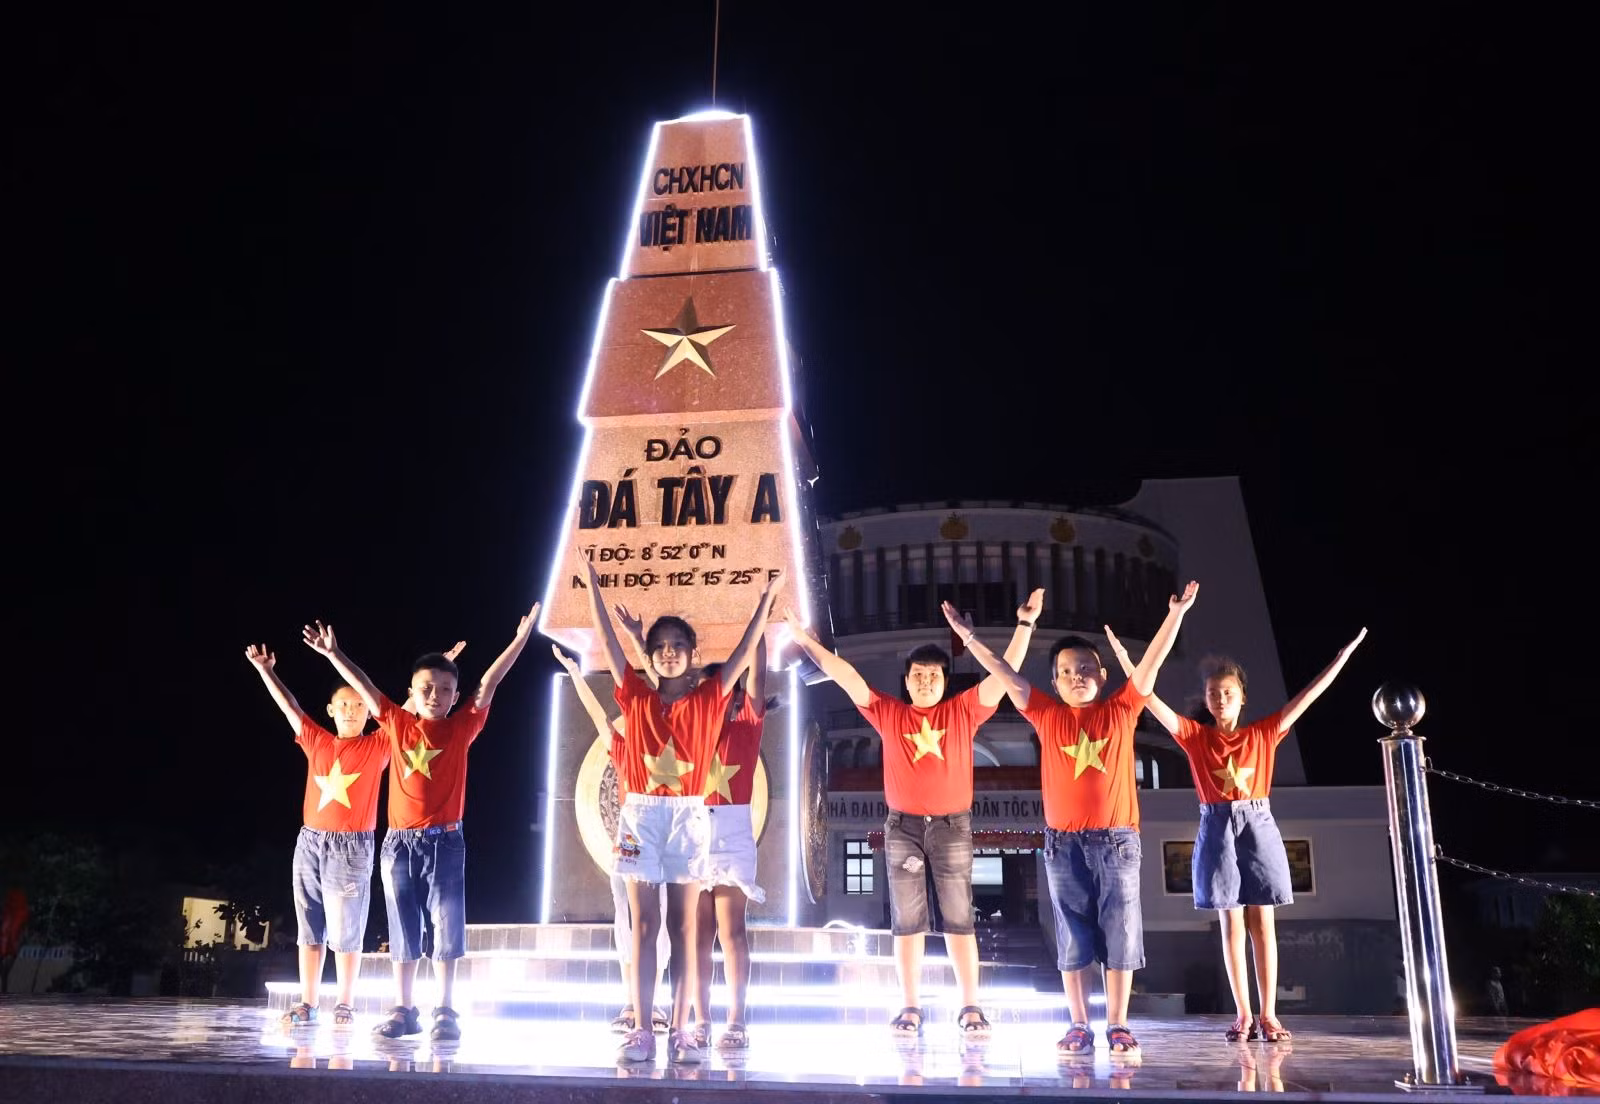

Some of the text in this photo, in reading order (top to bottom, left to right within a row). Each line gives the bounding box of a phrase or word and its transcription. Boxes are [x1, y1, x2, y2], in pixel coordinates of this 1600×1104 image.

[653, 163, 744, 195] CHXHCN
[639, 203, 753, 251] VIỆT NAM
[644, 427, 722, 462] ĐẢO
[578, 465, 782, 530] ĐÁ TÂY A
[599, 543, 636, 566] ĐỘ:
[711, 545, 726, 559] N
[572, 573, 619, 589] KNH
[624, 568, 661, 591] ĐỘ:
[1004, 796, 1030, 821] TỘC
